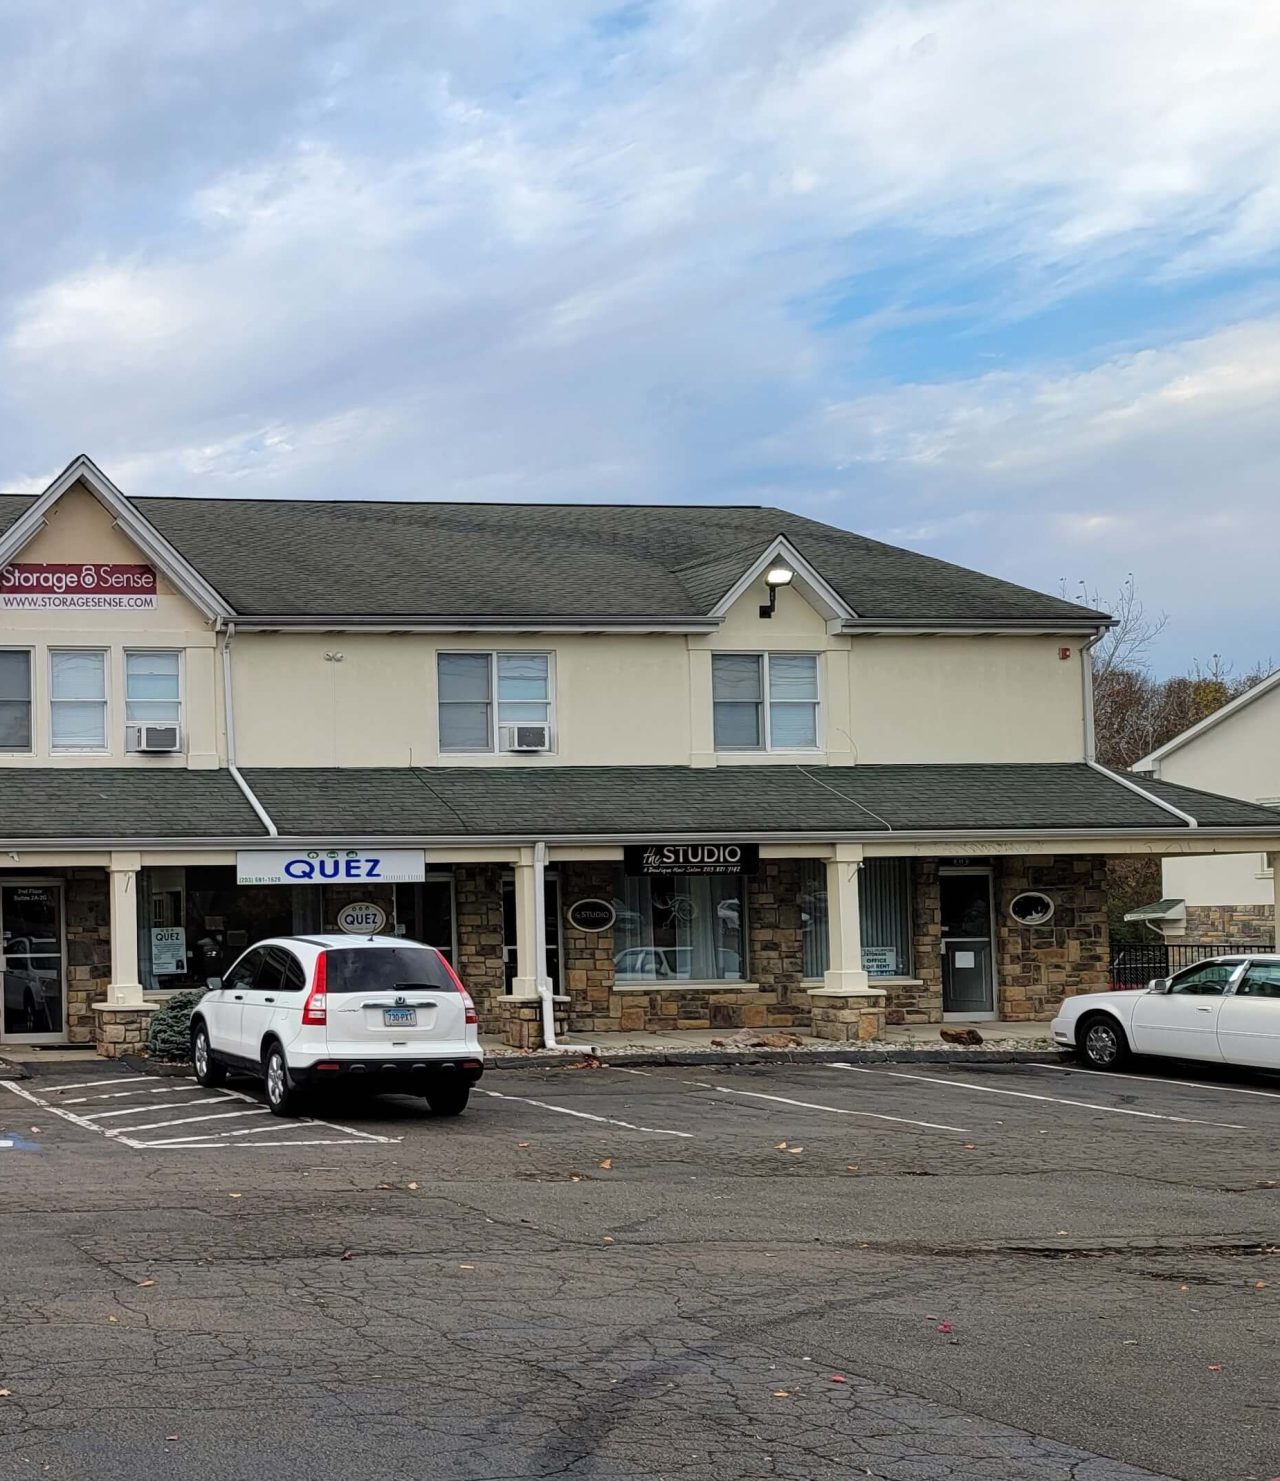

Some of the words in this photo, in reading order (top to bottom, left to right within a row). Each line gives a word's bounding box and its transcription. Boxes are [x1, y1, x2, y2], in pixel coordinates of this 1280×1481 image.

[2, 566, 78, 592] Storage
[100, 566, 154, 588] Sense
[3, 596, 154, 608] WWW.STORAGESENSE.COM
[663, 846, 741, 863] STUDIO
[284, 859, 382, 880] QUEZ
[344, 913, 378, 925] QUEZ
[155, 932, 180, 941] QUEZ
